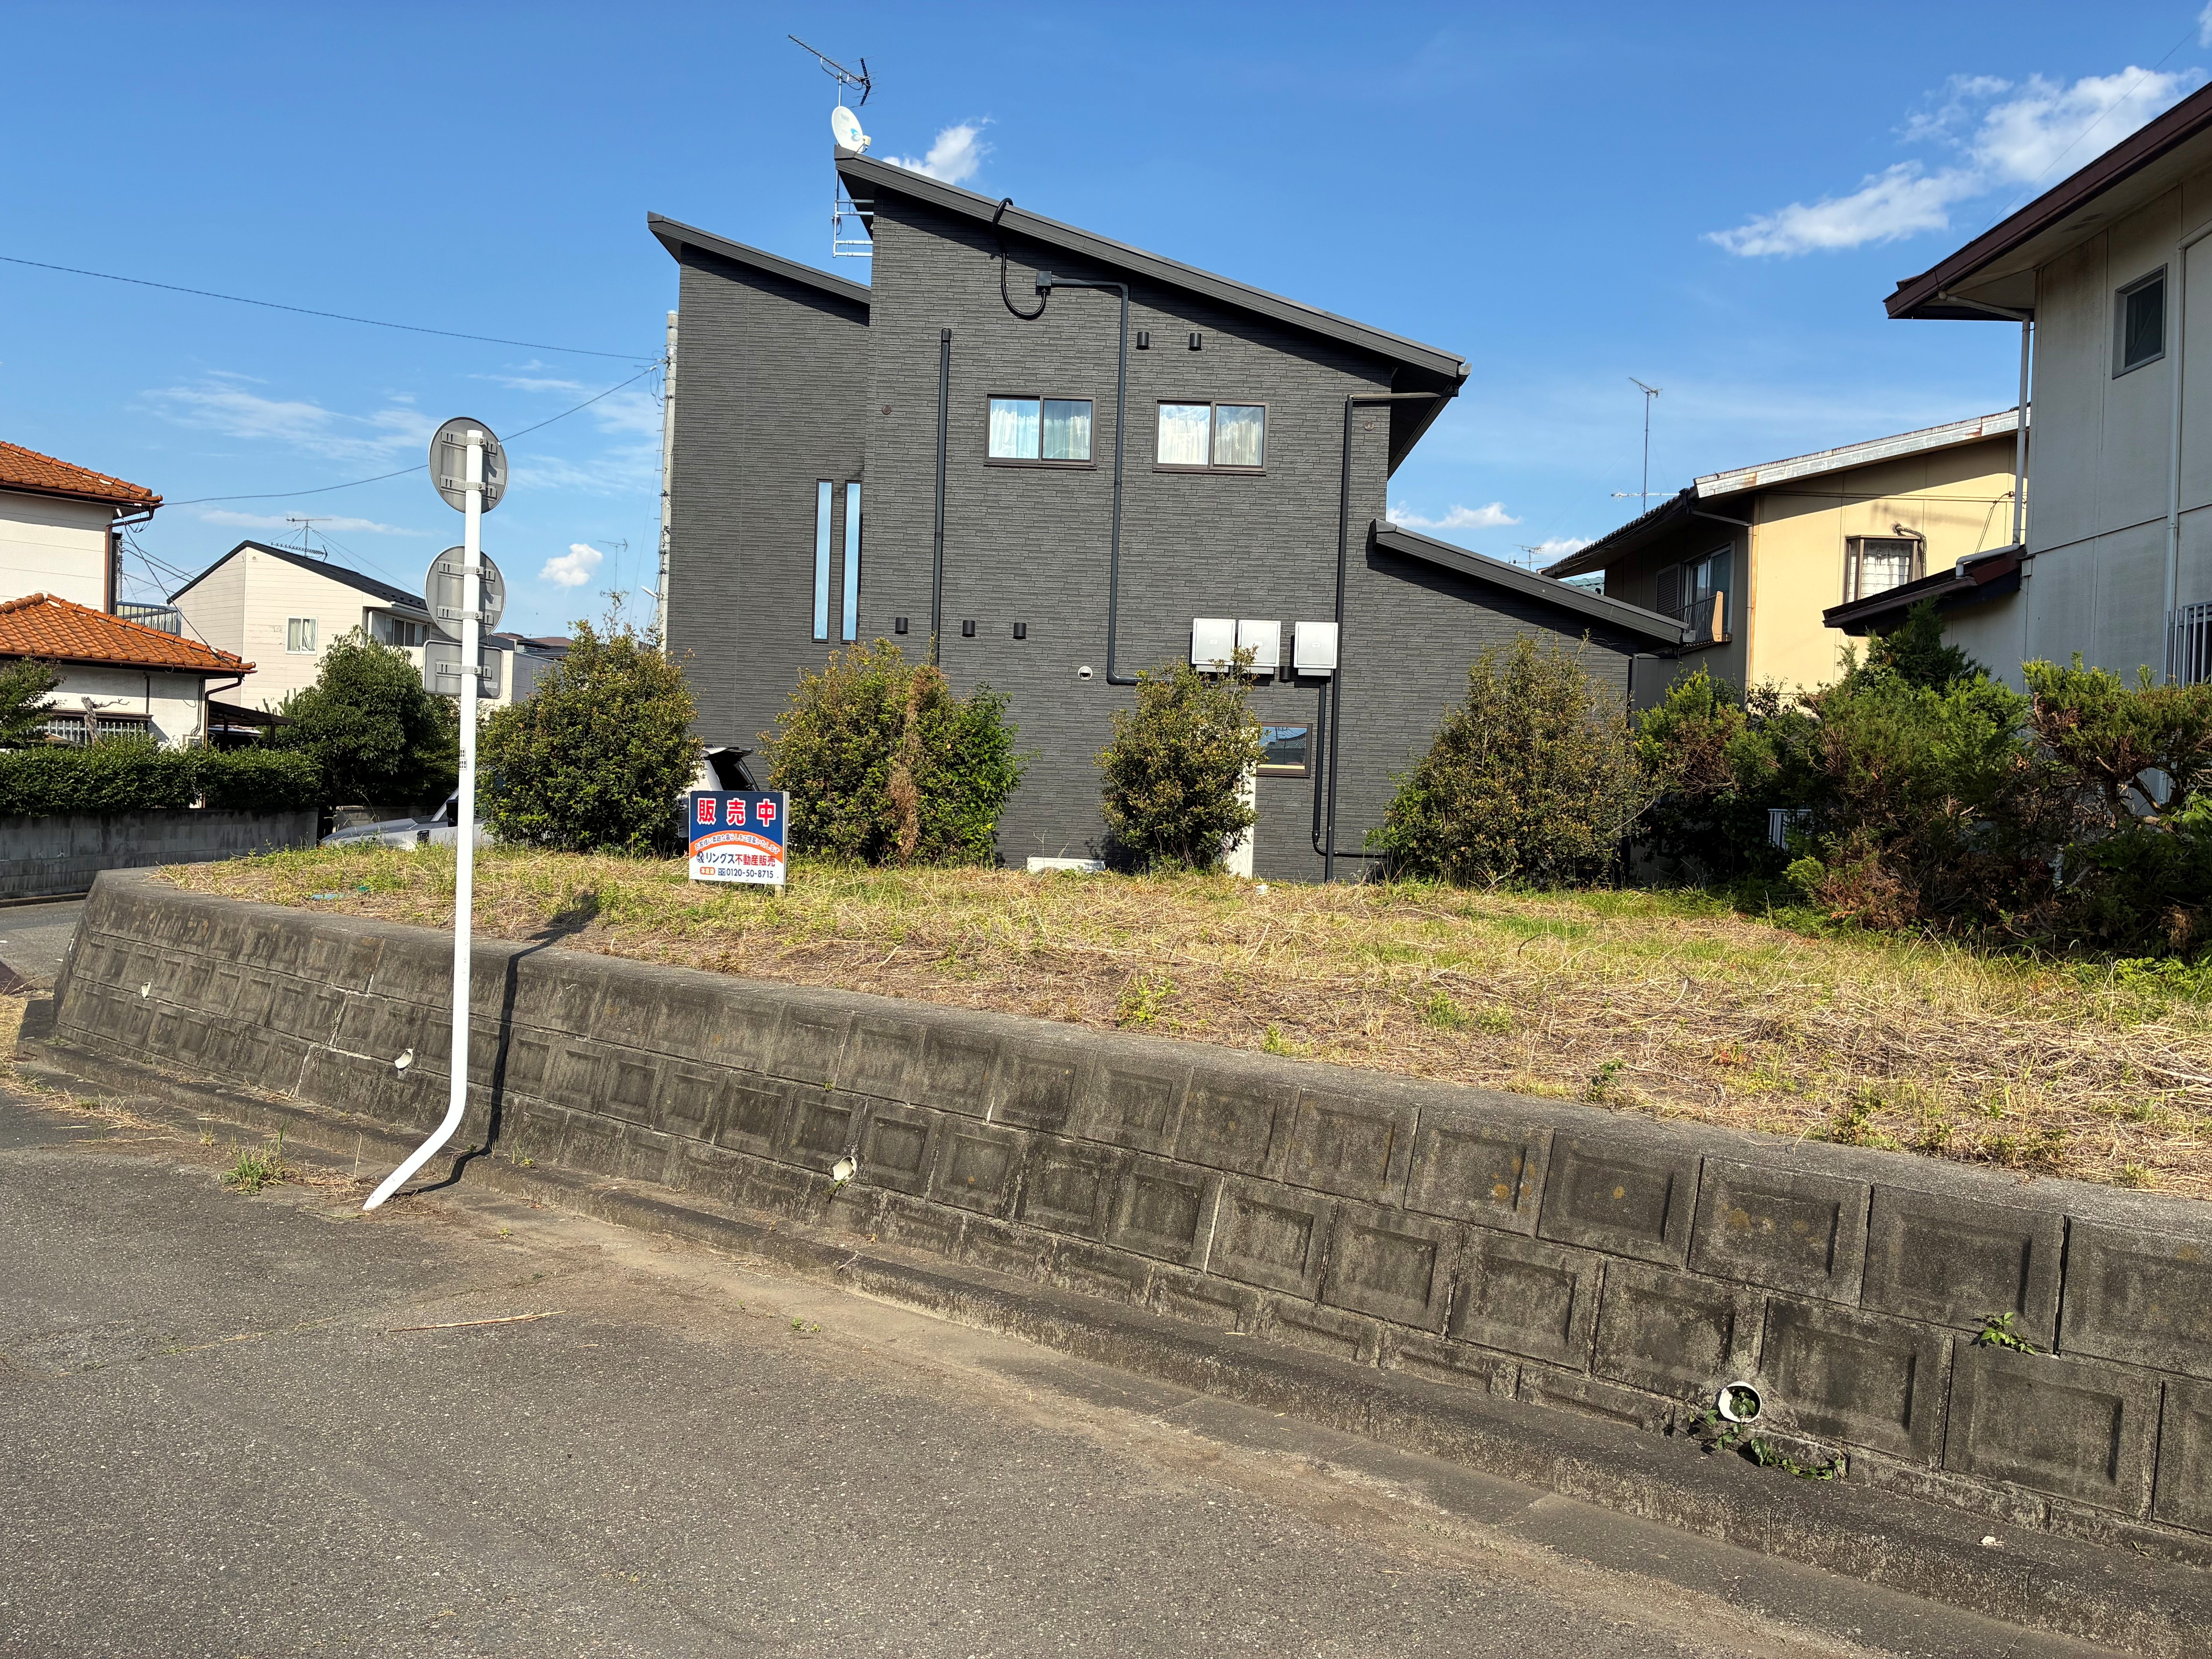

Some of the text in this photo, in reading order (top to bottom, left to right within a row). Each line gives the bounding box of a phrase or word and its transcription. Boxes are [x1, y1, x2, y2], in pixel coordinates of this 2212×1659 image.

[698, 798, 776, 826] 販売中
[706, 852, 775, 867] リングス不動産販売
[726, 868, 773, 878] 0120-50-8715
